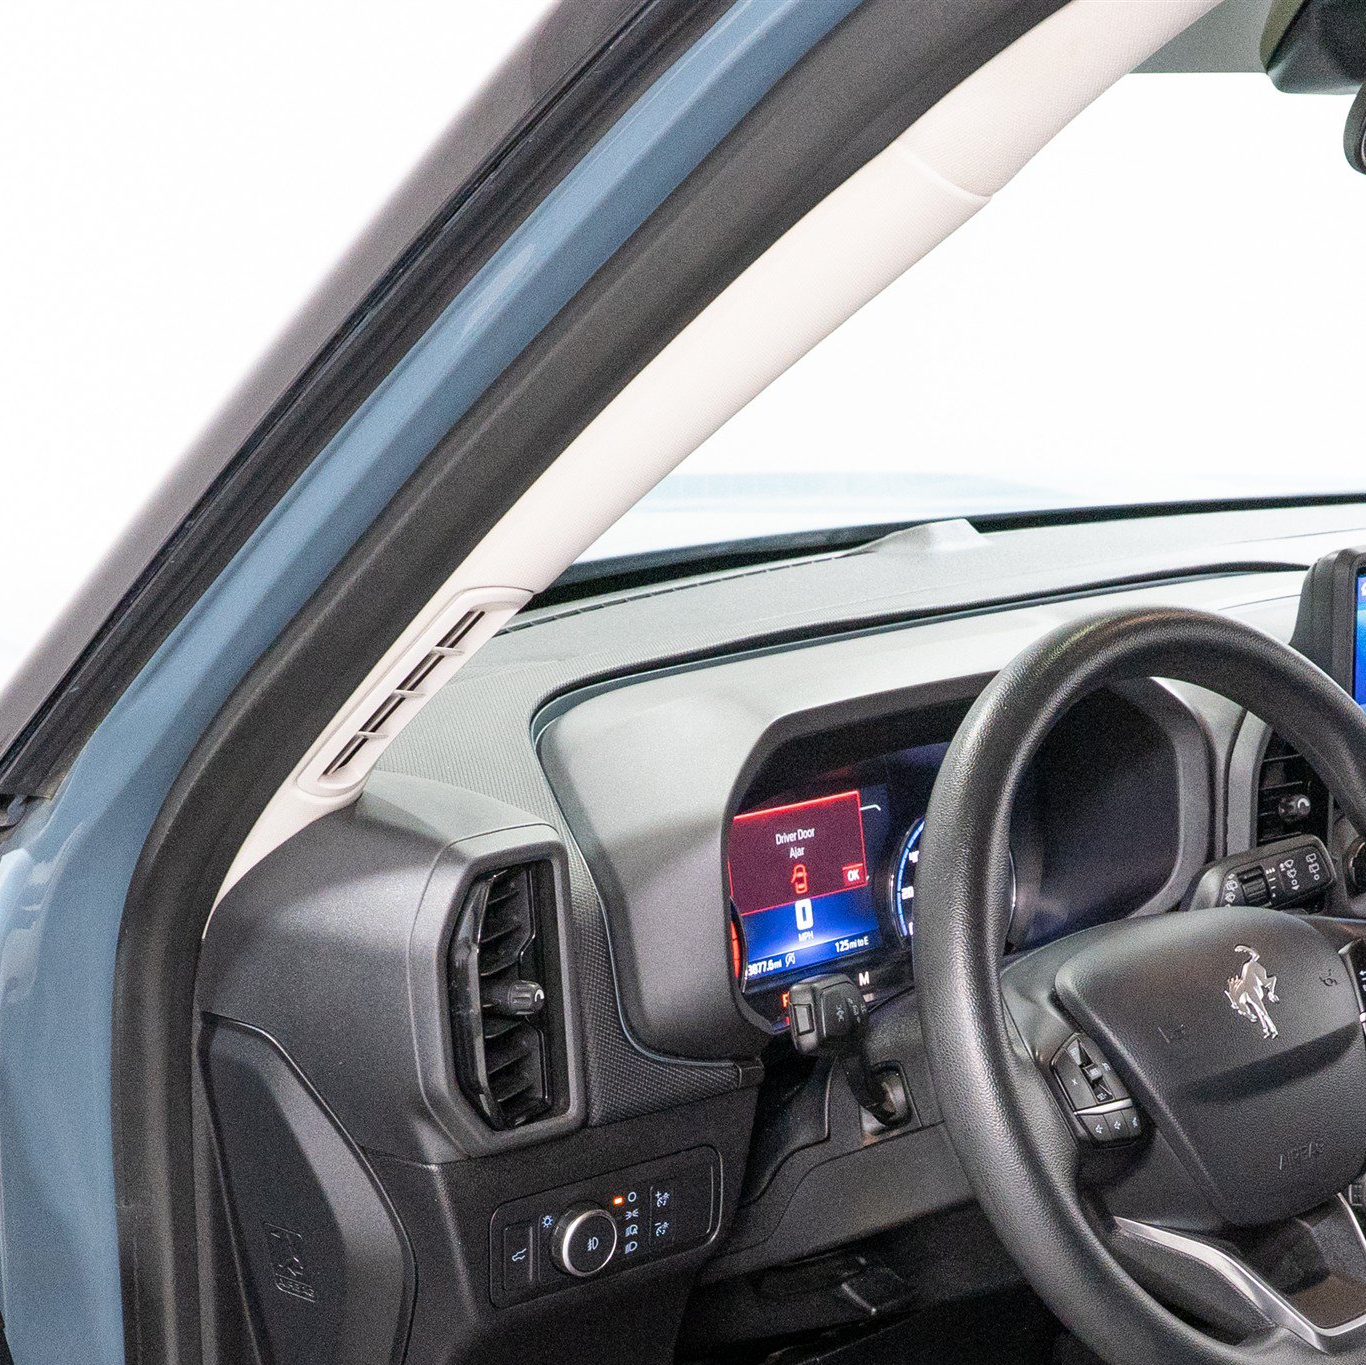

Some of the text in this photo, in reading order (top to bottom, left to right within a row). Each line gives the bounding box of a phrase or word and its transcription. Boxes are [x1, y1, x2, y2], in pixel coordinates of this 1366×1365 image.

[775, 827, 815, 845] Driver Door
[789, 846, 805, 859] Ajar
[848, 870, 860, 882] OK
[795, 898, 814, 931] 0
[798, 931, 814, 942] MPH
